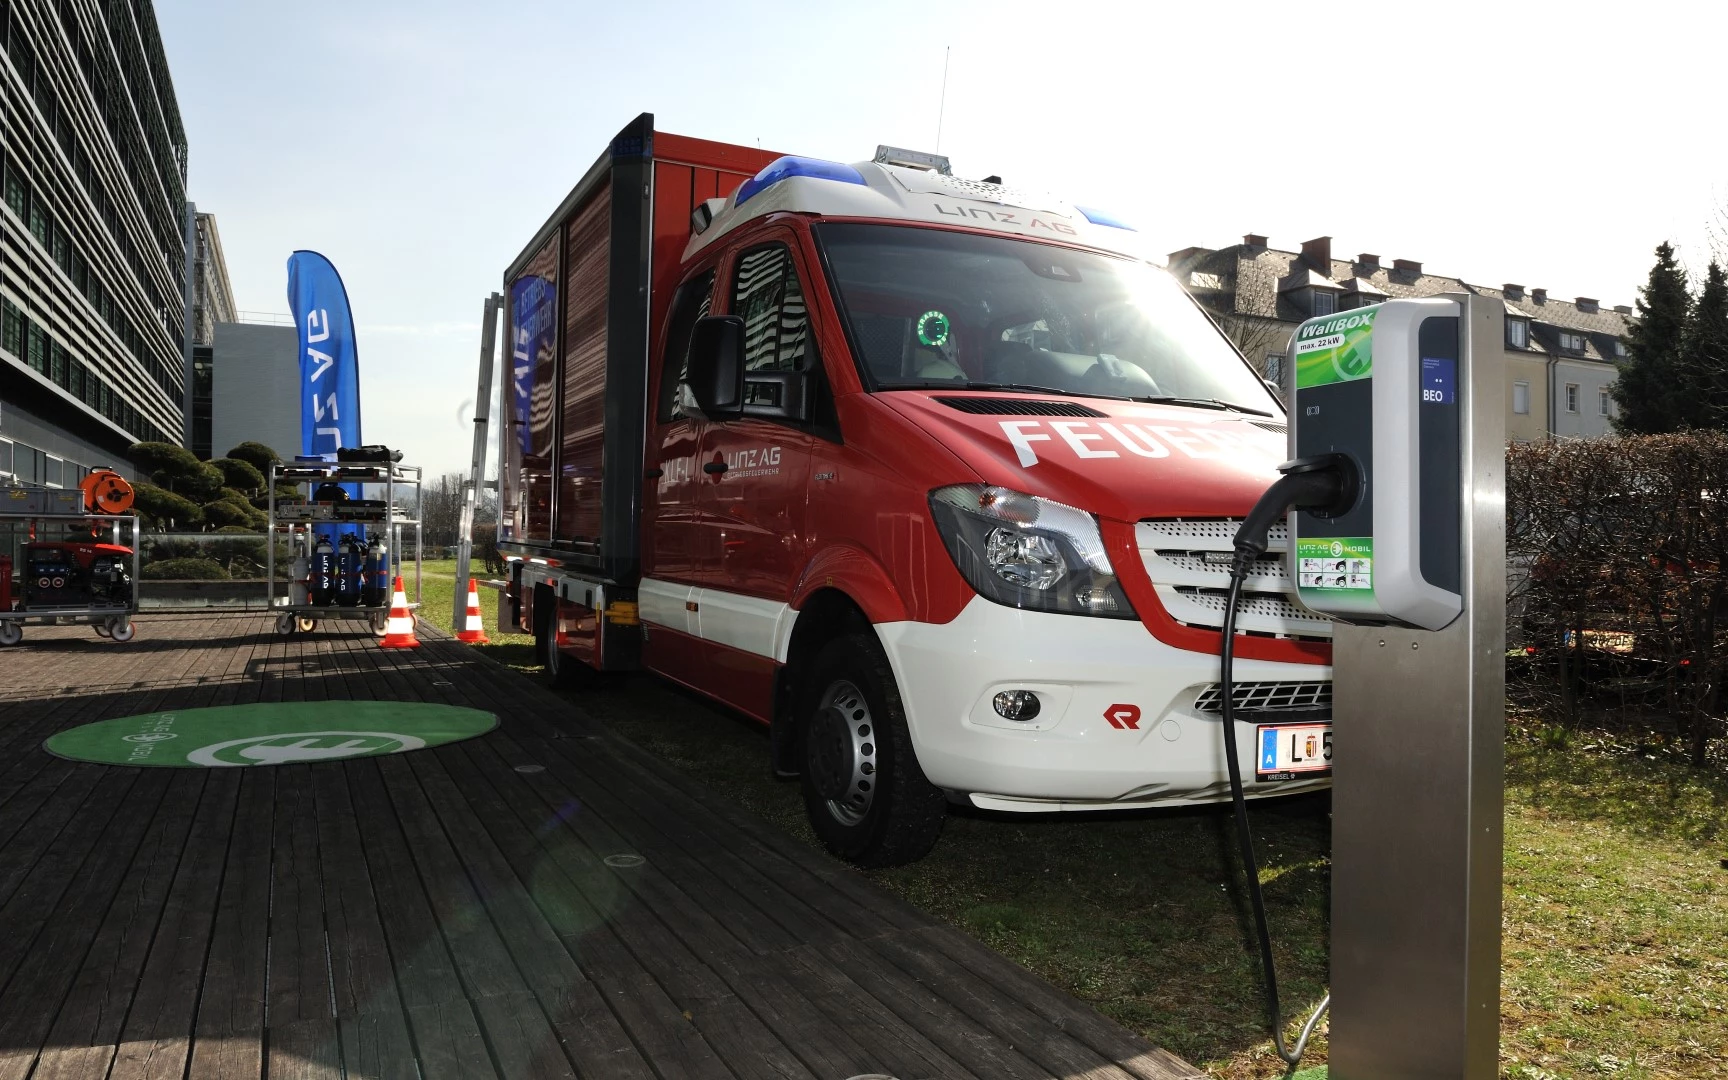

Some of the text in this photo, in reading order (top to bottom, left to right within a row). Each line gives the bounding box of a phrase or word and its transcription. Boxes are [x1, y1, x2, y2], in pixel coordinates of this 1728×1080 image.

[933, 203, 1077, 236] LINZ AG
[917, 310, 945, 335] STRASSE
[1302, 312, 1373, 338] WallBOX
[1300, 336, 1340, 351] max. 22 kW
[1423, 389, 1443, 402] BEO
[998, 421, 1285, 468] FEUER
[728, 446, 781, 470] LINZ AG
[1265, 754, 1273, 764] A
[1291, 732, 1332, 762] L 5
